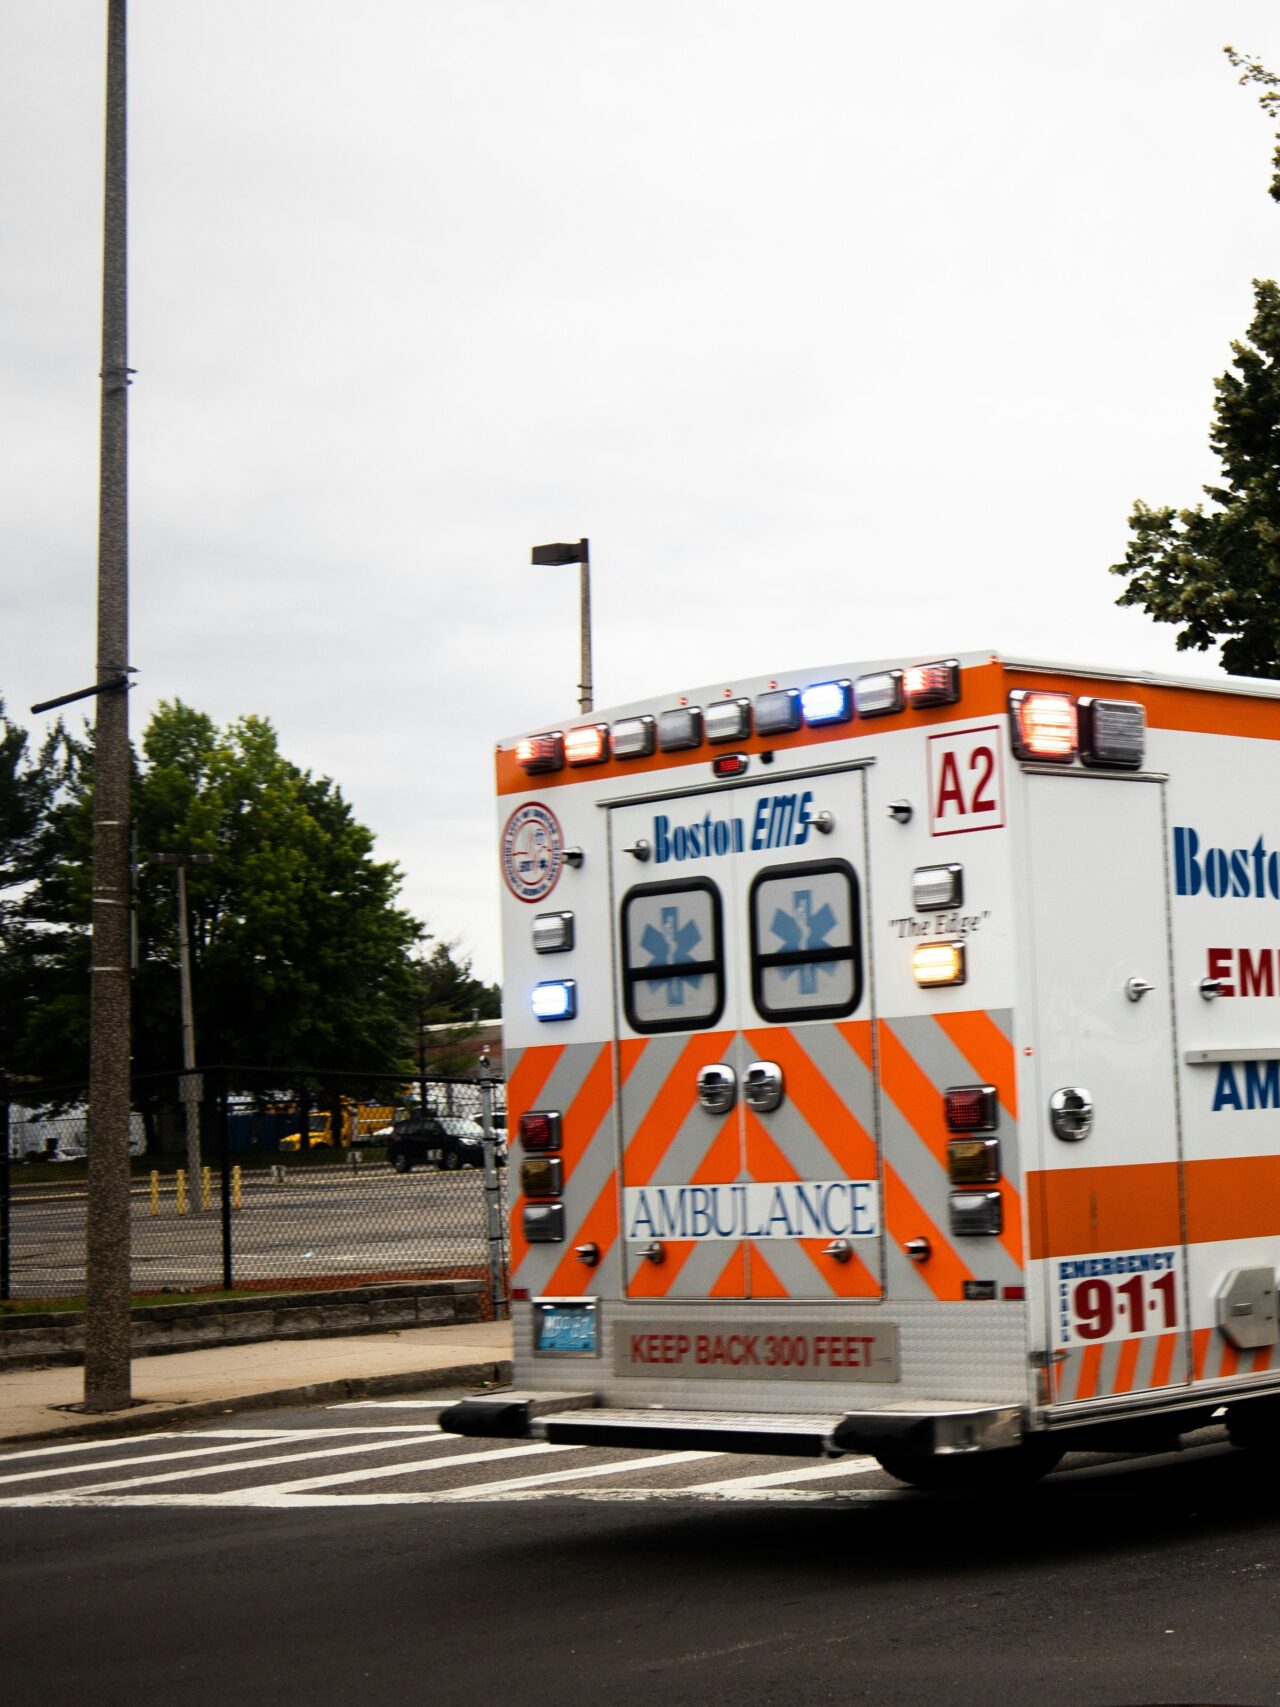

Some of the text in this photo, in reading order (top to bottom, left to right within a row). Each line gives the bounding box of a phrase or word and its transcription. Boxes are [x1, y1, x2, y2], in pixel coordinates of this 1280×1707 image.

[937, 746, 995, 817] A2
[654, 810, 744, 863] Boston
[630, 1183, 876, 1237] AMBULANCE
[1059, 1252, 1175, 1279] EMERGENCY
[1059, 1283, 1070, 1342] CALL
[630, 1334, 876, 1367] KEEP BACK 300 FEET
